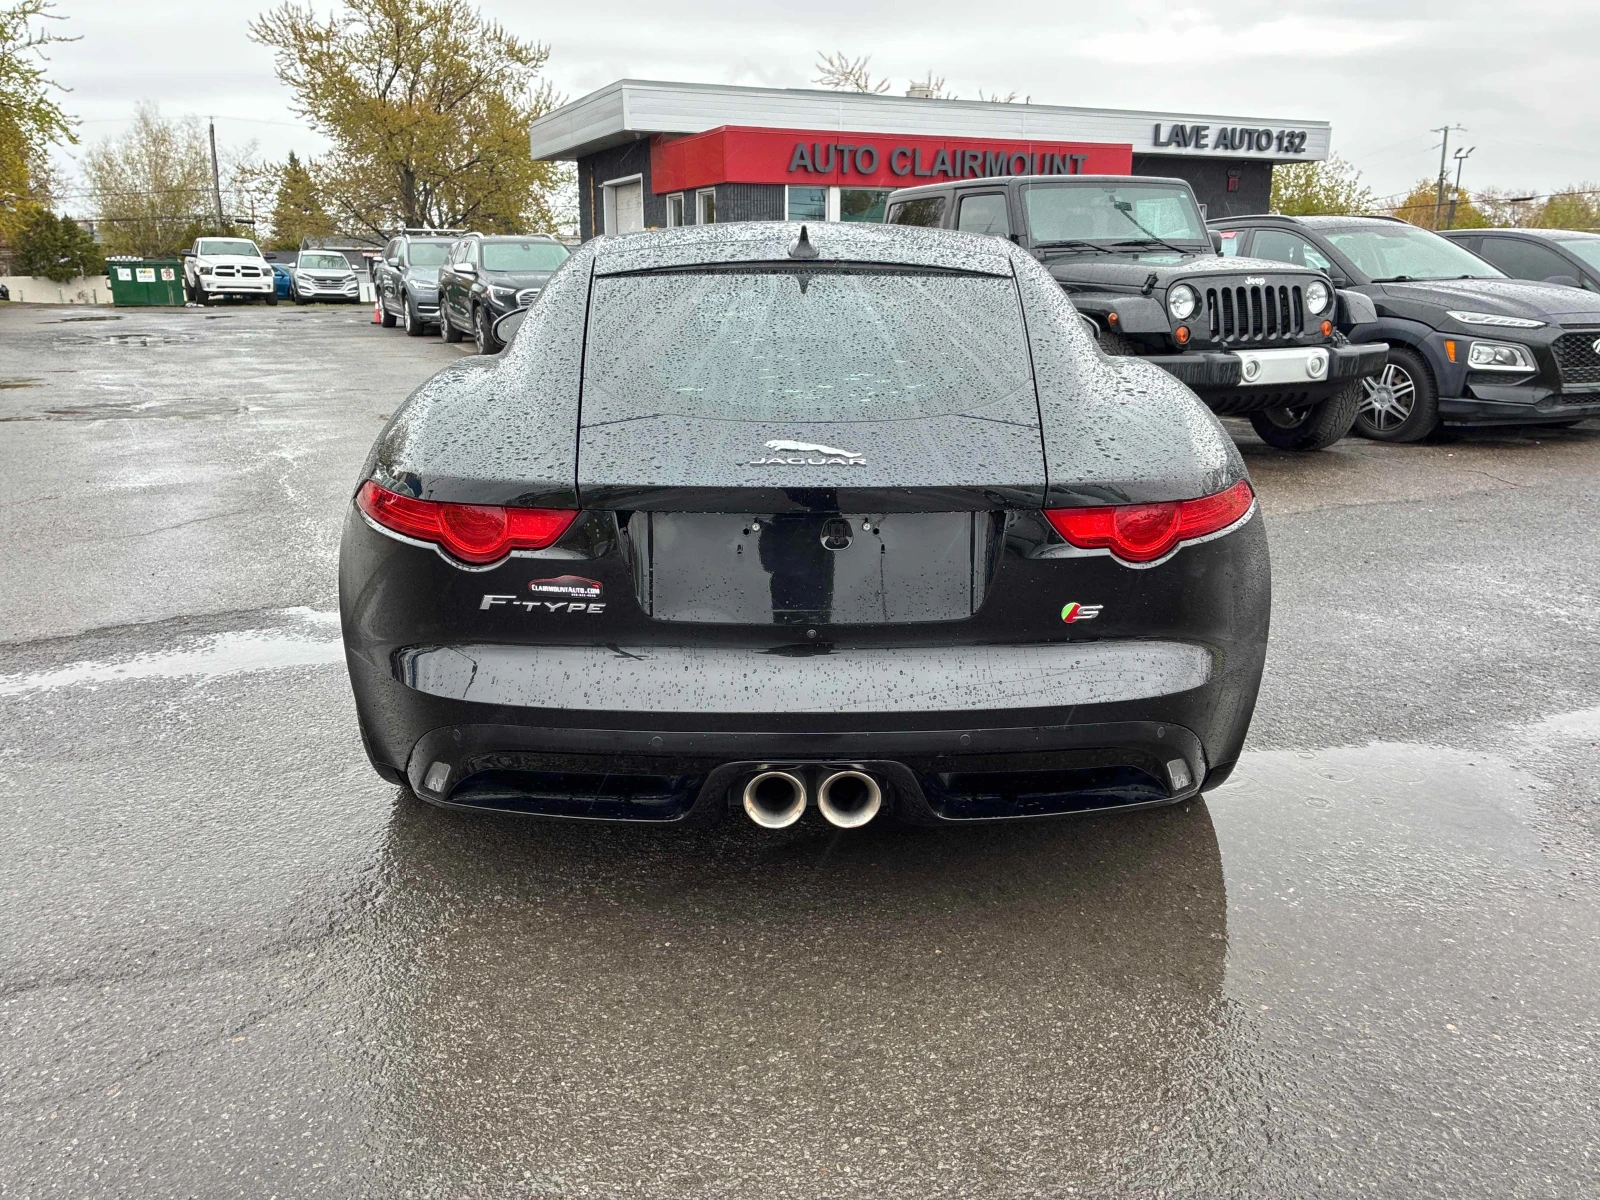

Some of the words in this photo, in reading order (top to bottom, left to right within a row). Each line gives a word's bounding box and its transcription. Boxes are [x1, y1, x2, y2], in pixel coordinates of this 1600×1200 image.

[1154, 123, 1210, 149] LAVE
[1213, 127, 1273, 151] AUTO
[1275, 130, 1307, 153] 132
[788, 142, 879, 175] AUTO
[890, 146, 1089, 178] CLAIRMOUNT
[1244, 276, 1266, 286] Jeep
[749, 457, 867, 466] JAGUAR
[479, 594, 606, 614] F-TYPE
